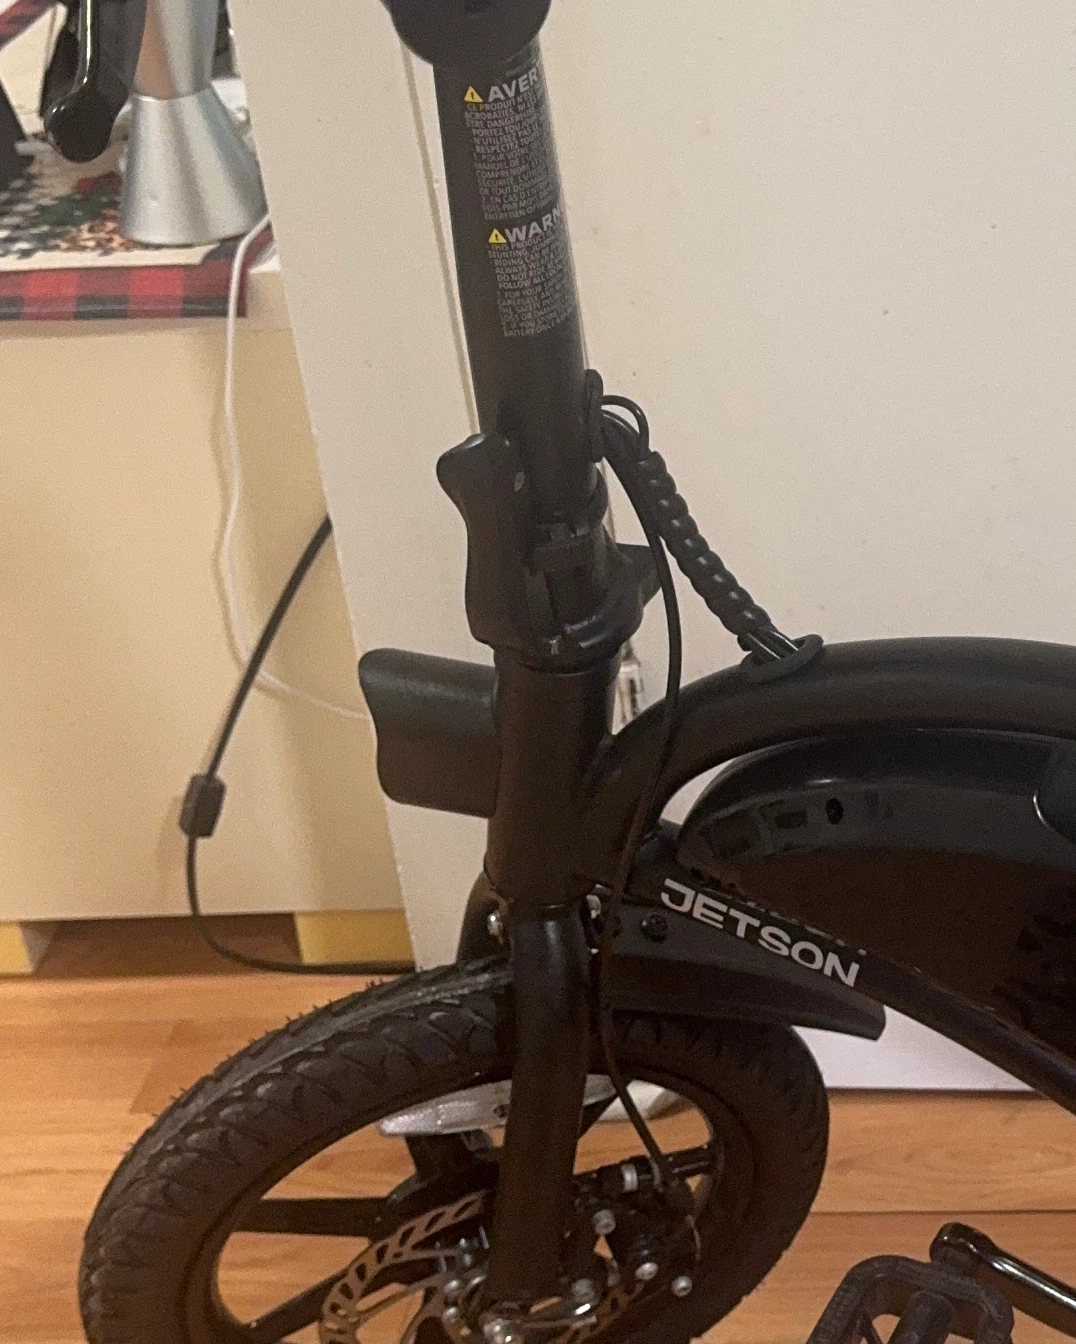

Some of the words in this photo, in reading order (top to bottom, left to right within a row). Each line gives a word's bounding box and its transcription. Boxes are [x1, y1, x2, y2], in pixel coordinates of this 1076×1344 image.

[472, 128, 504, 137] PORTEZ
[511, 272, 527, 281] NOT
[498, 279, 531, 289] FOLLOW
[660, 878, 861, 987] JETSON
